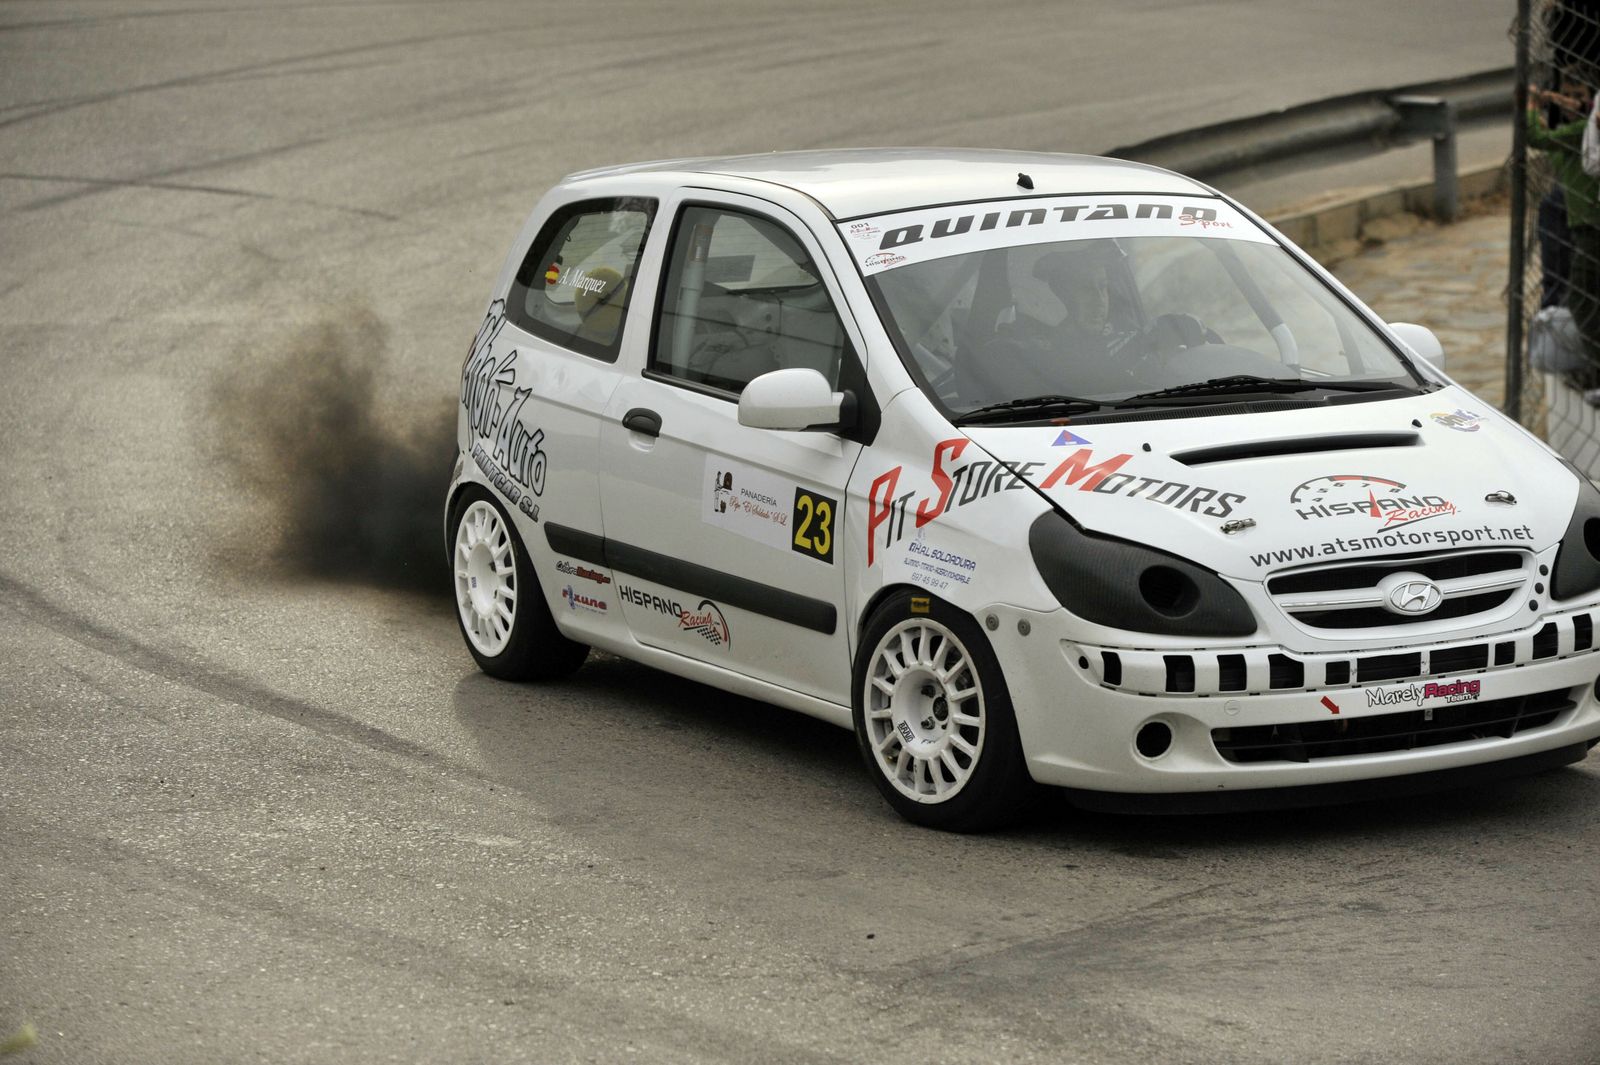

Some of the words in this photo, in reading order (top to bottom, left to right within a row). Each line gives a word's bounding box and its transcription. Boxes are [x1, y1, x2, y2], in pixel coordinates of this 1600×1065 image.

[879, 203, 1217, 250] QUINTANO
[794, 494, 832, 556] 23
[1295, 495, 1446, 521] HISPANO
[1384, 501, 1457, 527] Racing
[1249, 524, 1535, 568] www.atsmotorsport.net
[619, 585, 683, 618] HISPANO
[678, 610, 712, 630] Racing
[1445, 692, 1473, 704] Team
